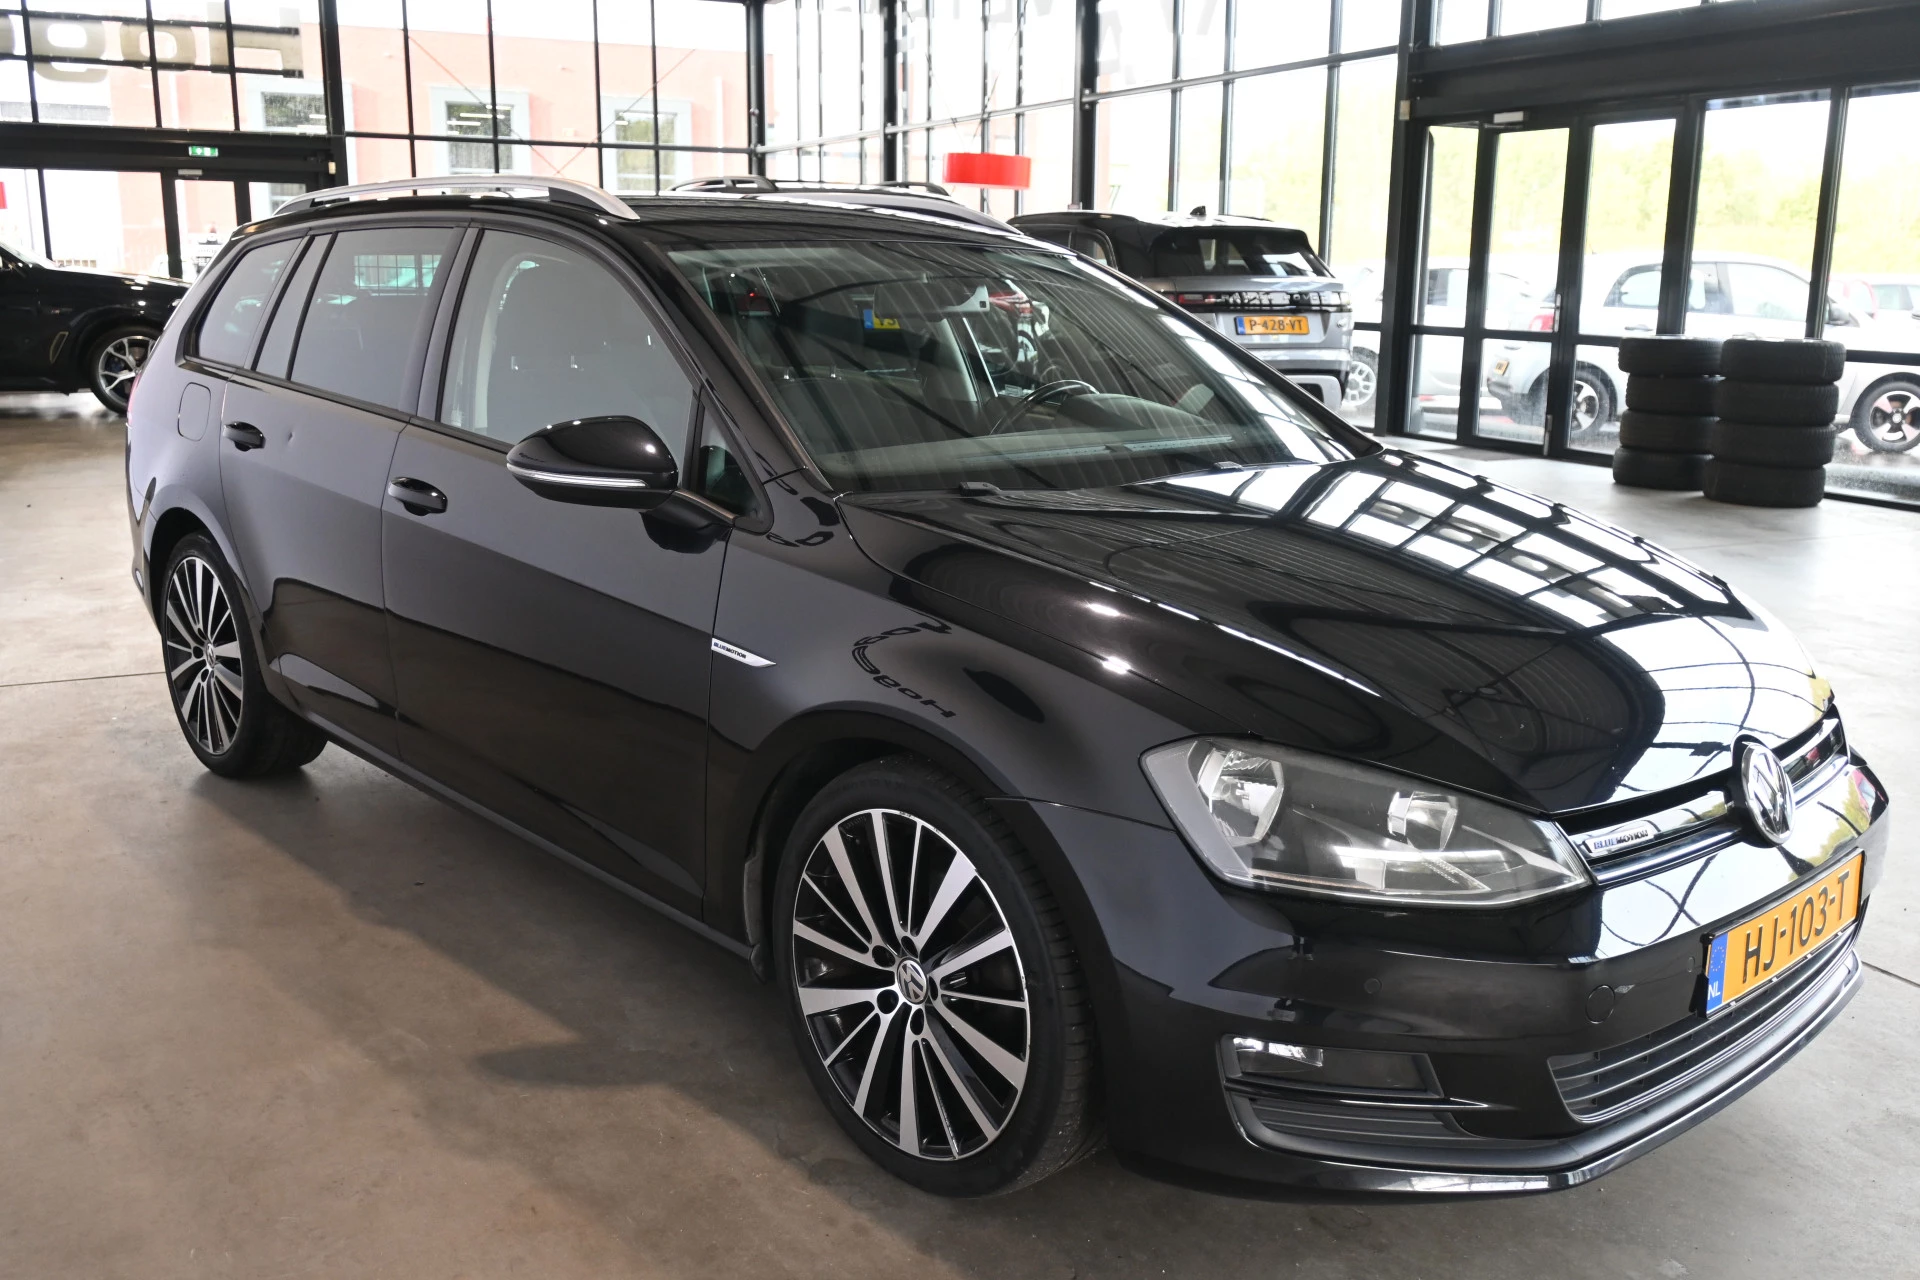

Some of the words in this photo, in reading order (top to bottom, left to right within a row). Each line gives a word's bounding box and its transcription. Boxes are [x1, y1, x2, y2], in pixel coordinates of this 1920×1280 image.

[1249, 319, 1303, 331] P-428-VT
[1743, 870, 1850, 984] HJ-103-T
[1707, 980, 1721, 1001] NL
